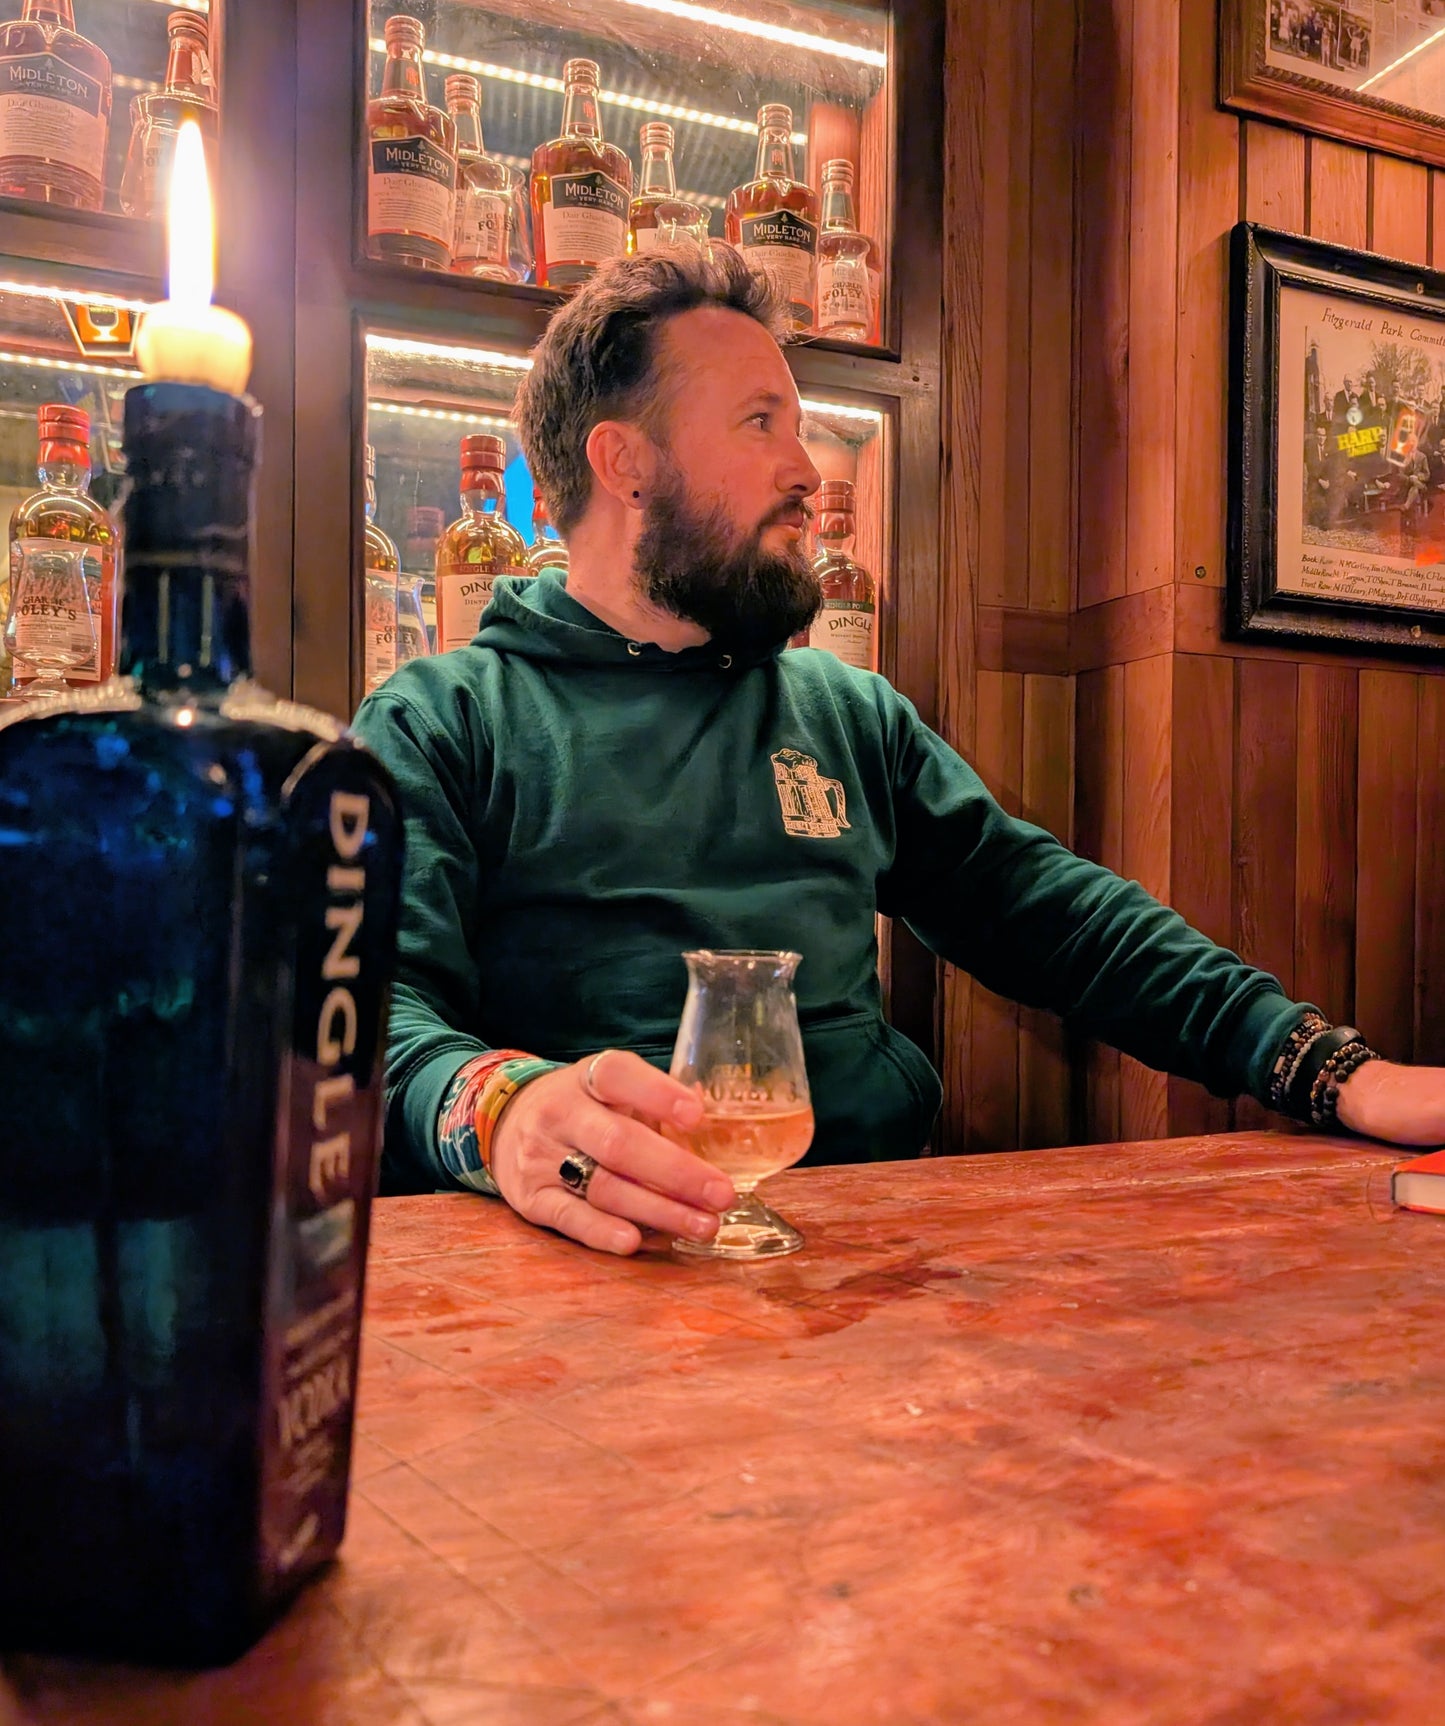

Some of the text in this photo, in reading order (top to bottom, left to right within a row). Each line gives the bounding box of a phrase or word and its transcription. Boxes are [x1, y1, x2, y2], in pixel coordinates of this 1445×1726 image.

[9, 65, 89, 99] MIDLETON
[386, 147, 449, 177] MIDLETON
[565, 182, 625, 209] MIDLETON
[579, 195, 597, 203] VERY
[753, 223, 811, 242] MIDLETON
[1321, 307, 1373, 330] Fitzgerald
[1380, 320, 1404, 338] Park
[828, 616, 873, 634] DINGLE
[308, 790, 370, 1199] DINGLE
